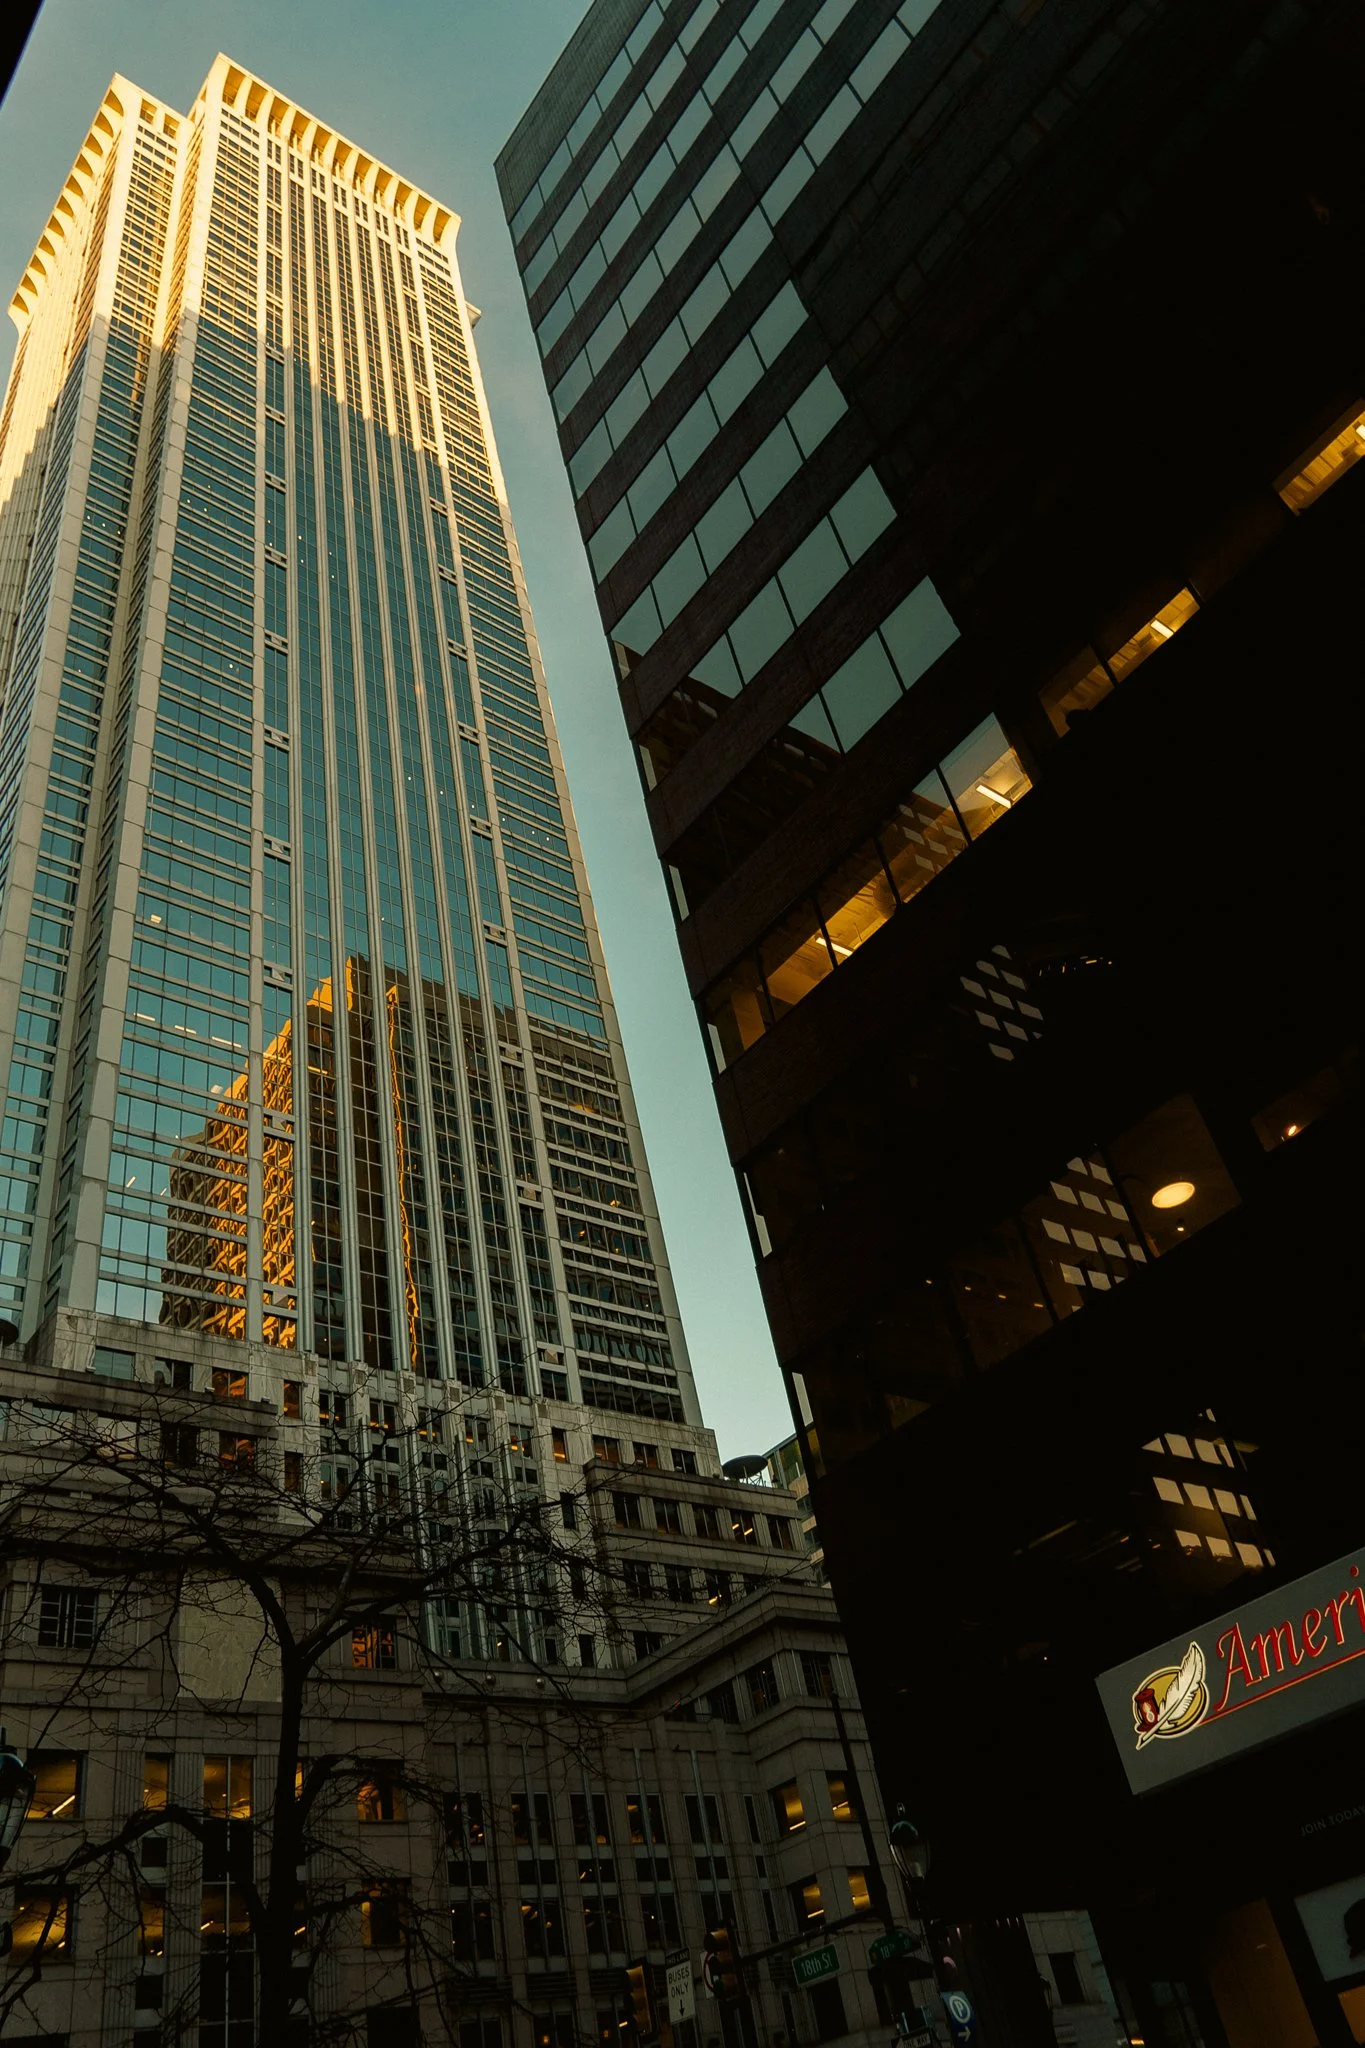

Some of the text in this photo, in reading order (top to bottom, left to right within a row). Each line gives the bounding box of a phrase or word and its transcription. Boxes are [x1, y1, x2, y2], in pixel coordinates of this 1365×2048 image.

[1213, 1564, 1365, 1712] Ameri
[1299, 1817, 1327, 1837] JOIN
[669, 1966, 689, 1983] BUSES
[801, 1952, 833, 1977] 18th St
[671, 1981, 689, 1998] ONLY
